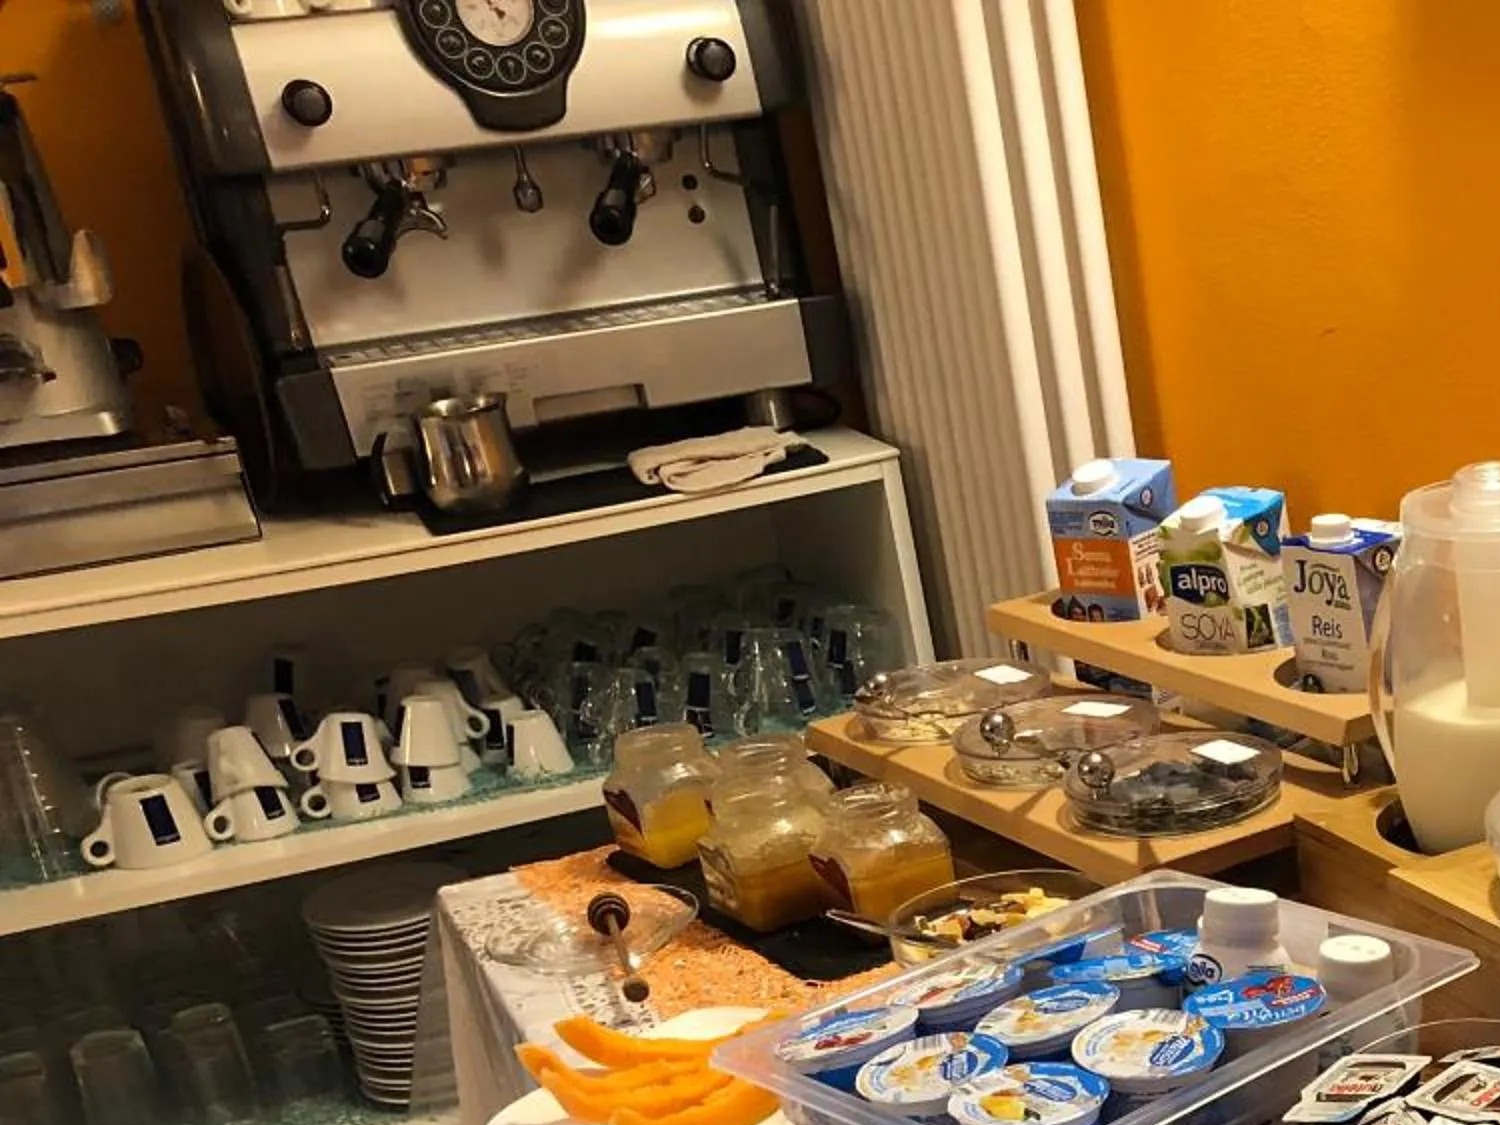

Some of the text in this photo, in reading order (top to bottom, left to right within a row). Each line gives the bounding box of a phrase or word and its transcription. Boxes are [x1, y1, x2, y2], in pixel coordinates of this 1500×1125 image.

[1177, 567, 1228, 597] alpro
[1293, 559, 1351, 607] Joya
[1181, 612, 1237, 641] SOYA
[1310, 614, 1344, 640] Reis
[1328, 1083, 1384, 1094] nutella
